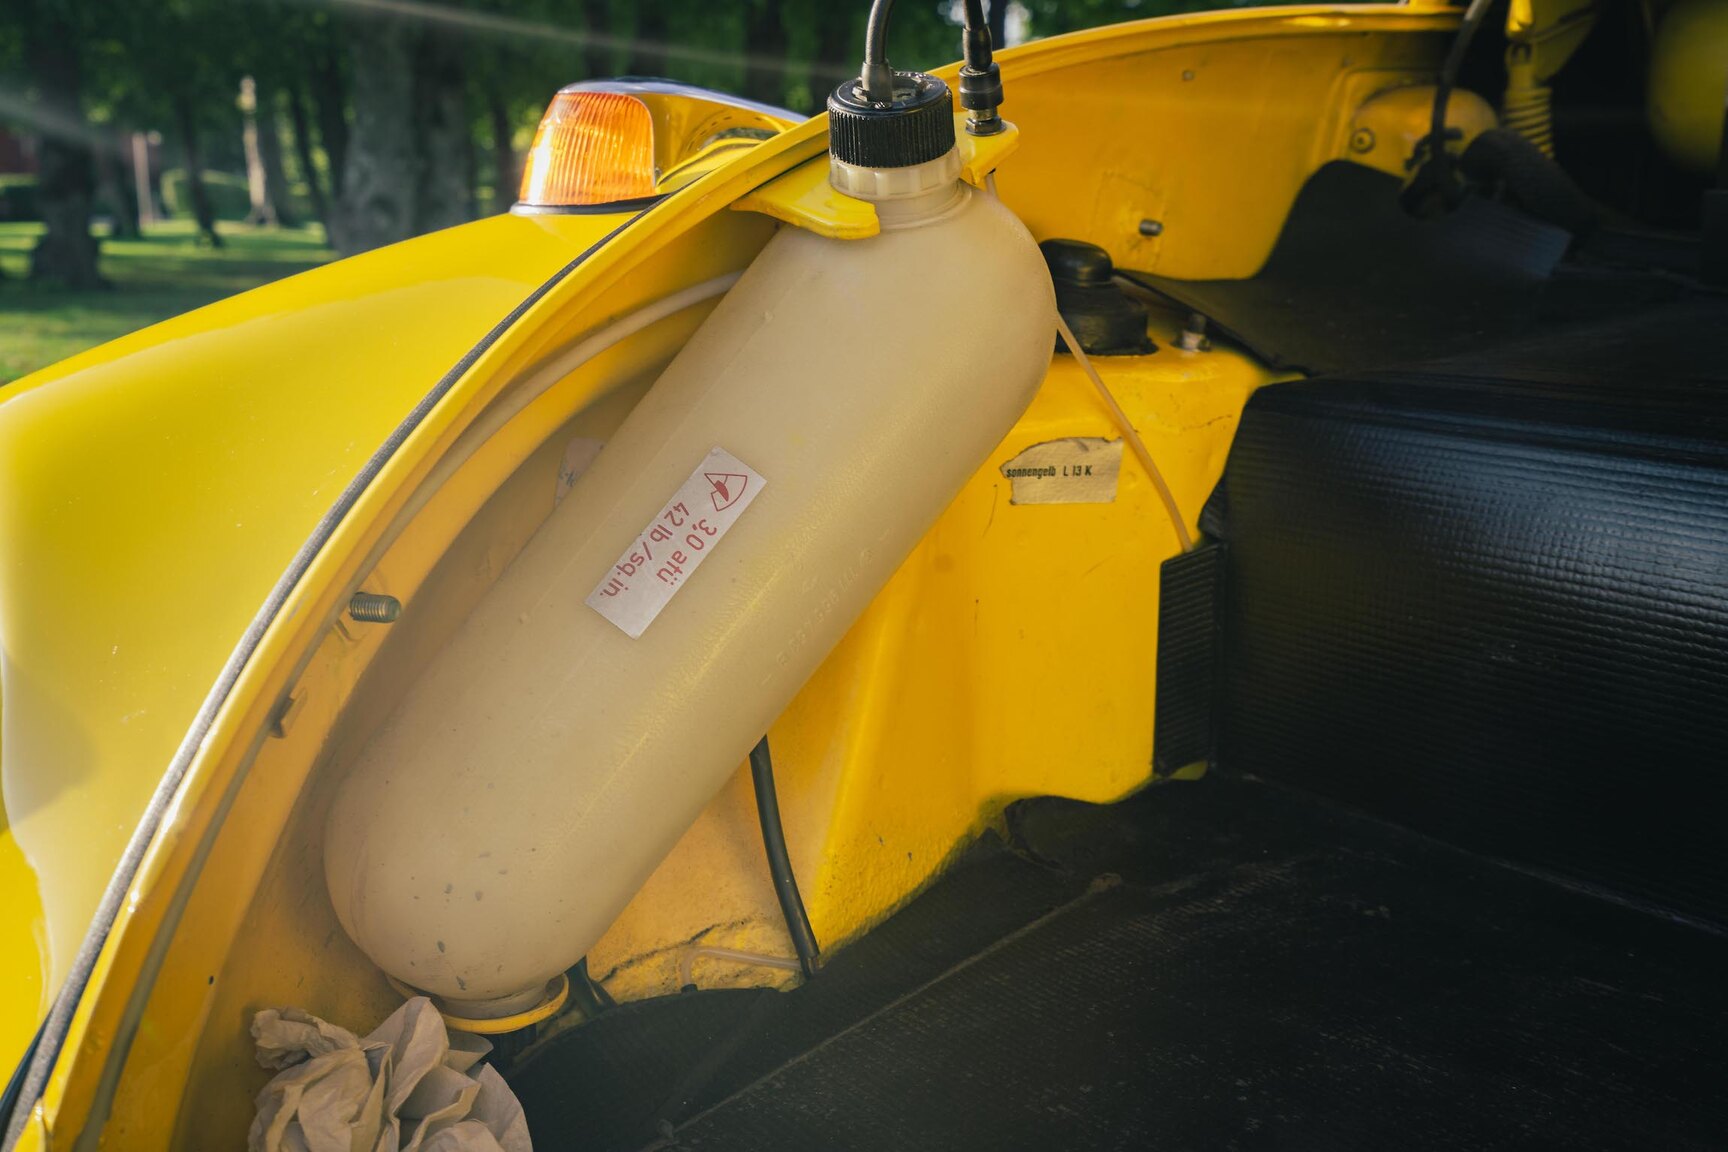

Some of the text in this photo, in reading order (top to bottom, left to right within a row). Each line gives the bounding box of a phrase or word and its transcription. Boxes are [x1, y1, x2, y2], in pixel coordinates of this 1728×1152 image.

[1006, 465, 1093, 479] sonnengelb L 13 K
[664, 502, 690, 527] 42
[656, 519, 718, 586] 3,0 atü
